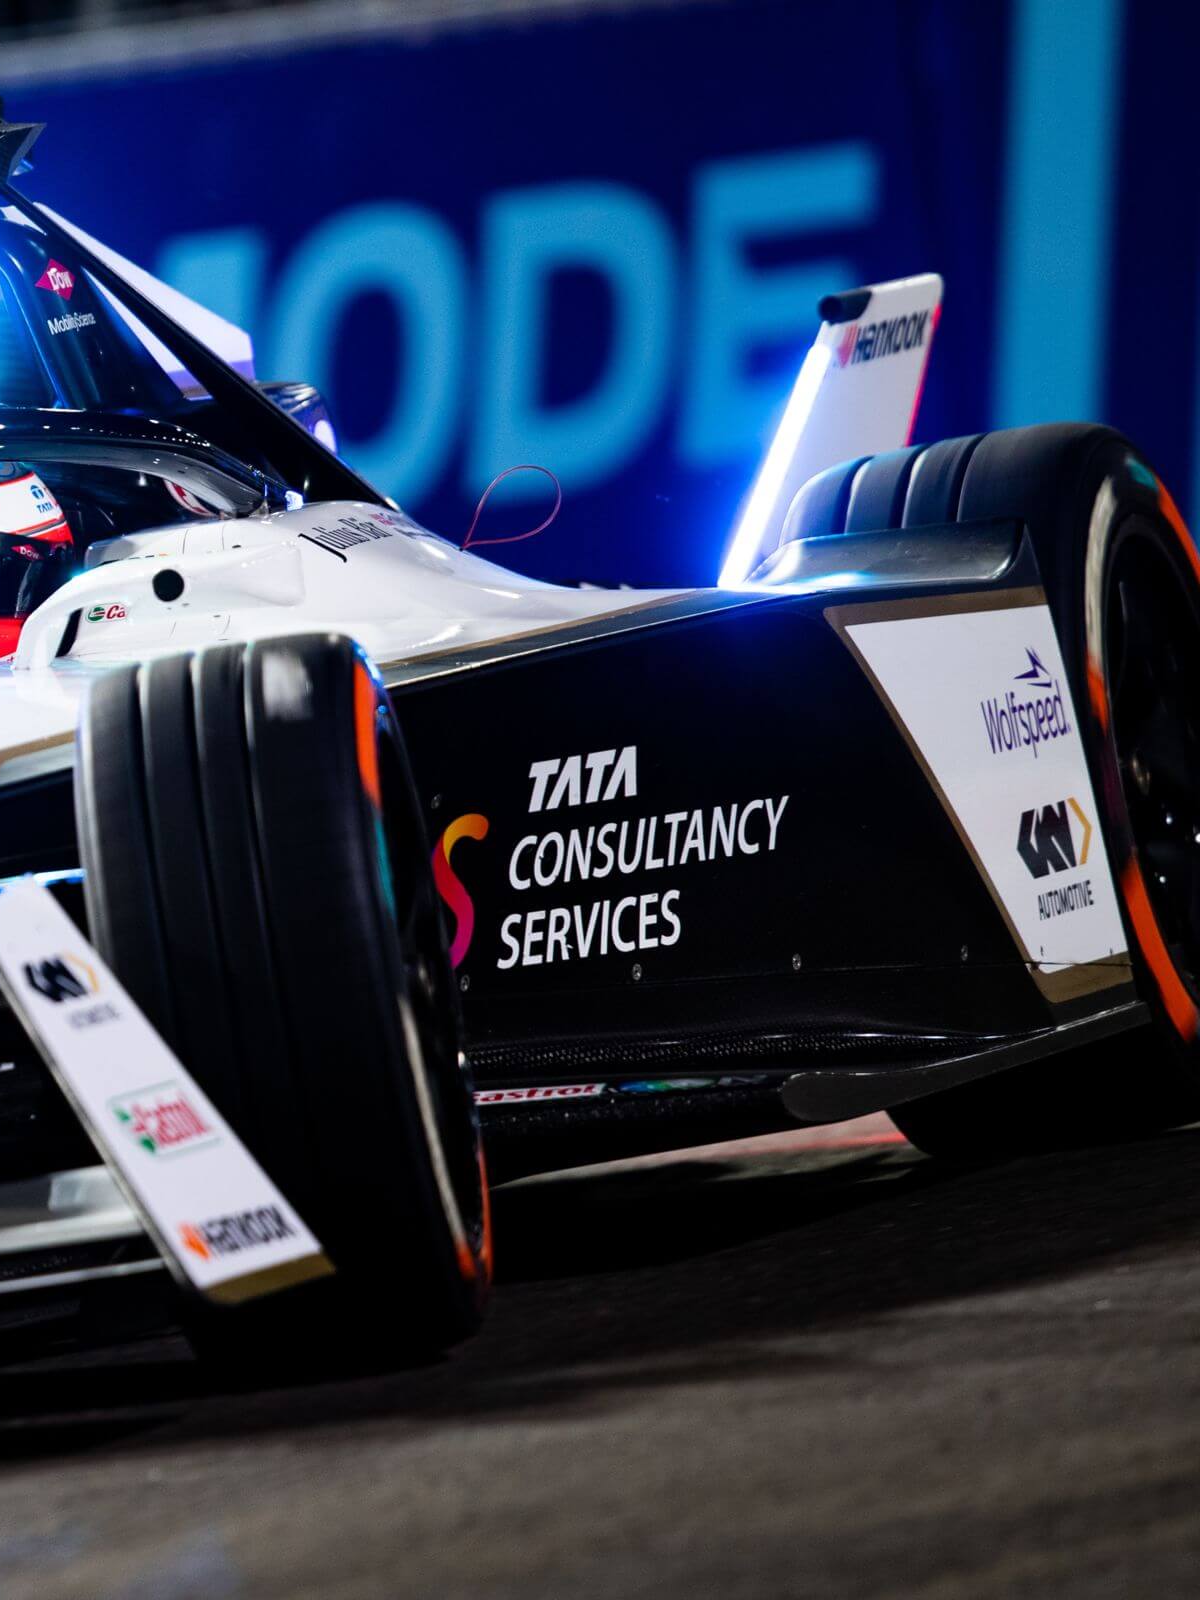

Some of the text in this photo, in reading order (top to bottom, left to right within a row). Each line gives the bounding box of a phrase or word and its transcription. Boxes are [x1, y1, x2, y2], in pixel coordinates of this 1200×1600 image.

[981, 679, 1070, 758] Wolfspeed
[528, 745, 637, 813] TATA
[508, 795, 789, 890] CONSULTANCY
[496, 889, 681, 970] SERVICES
[1037, 880, 1094, 920] AUTOMOTIVE
